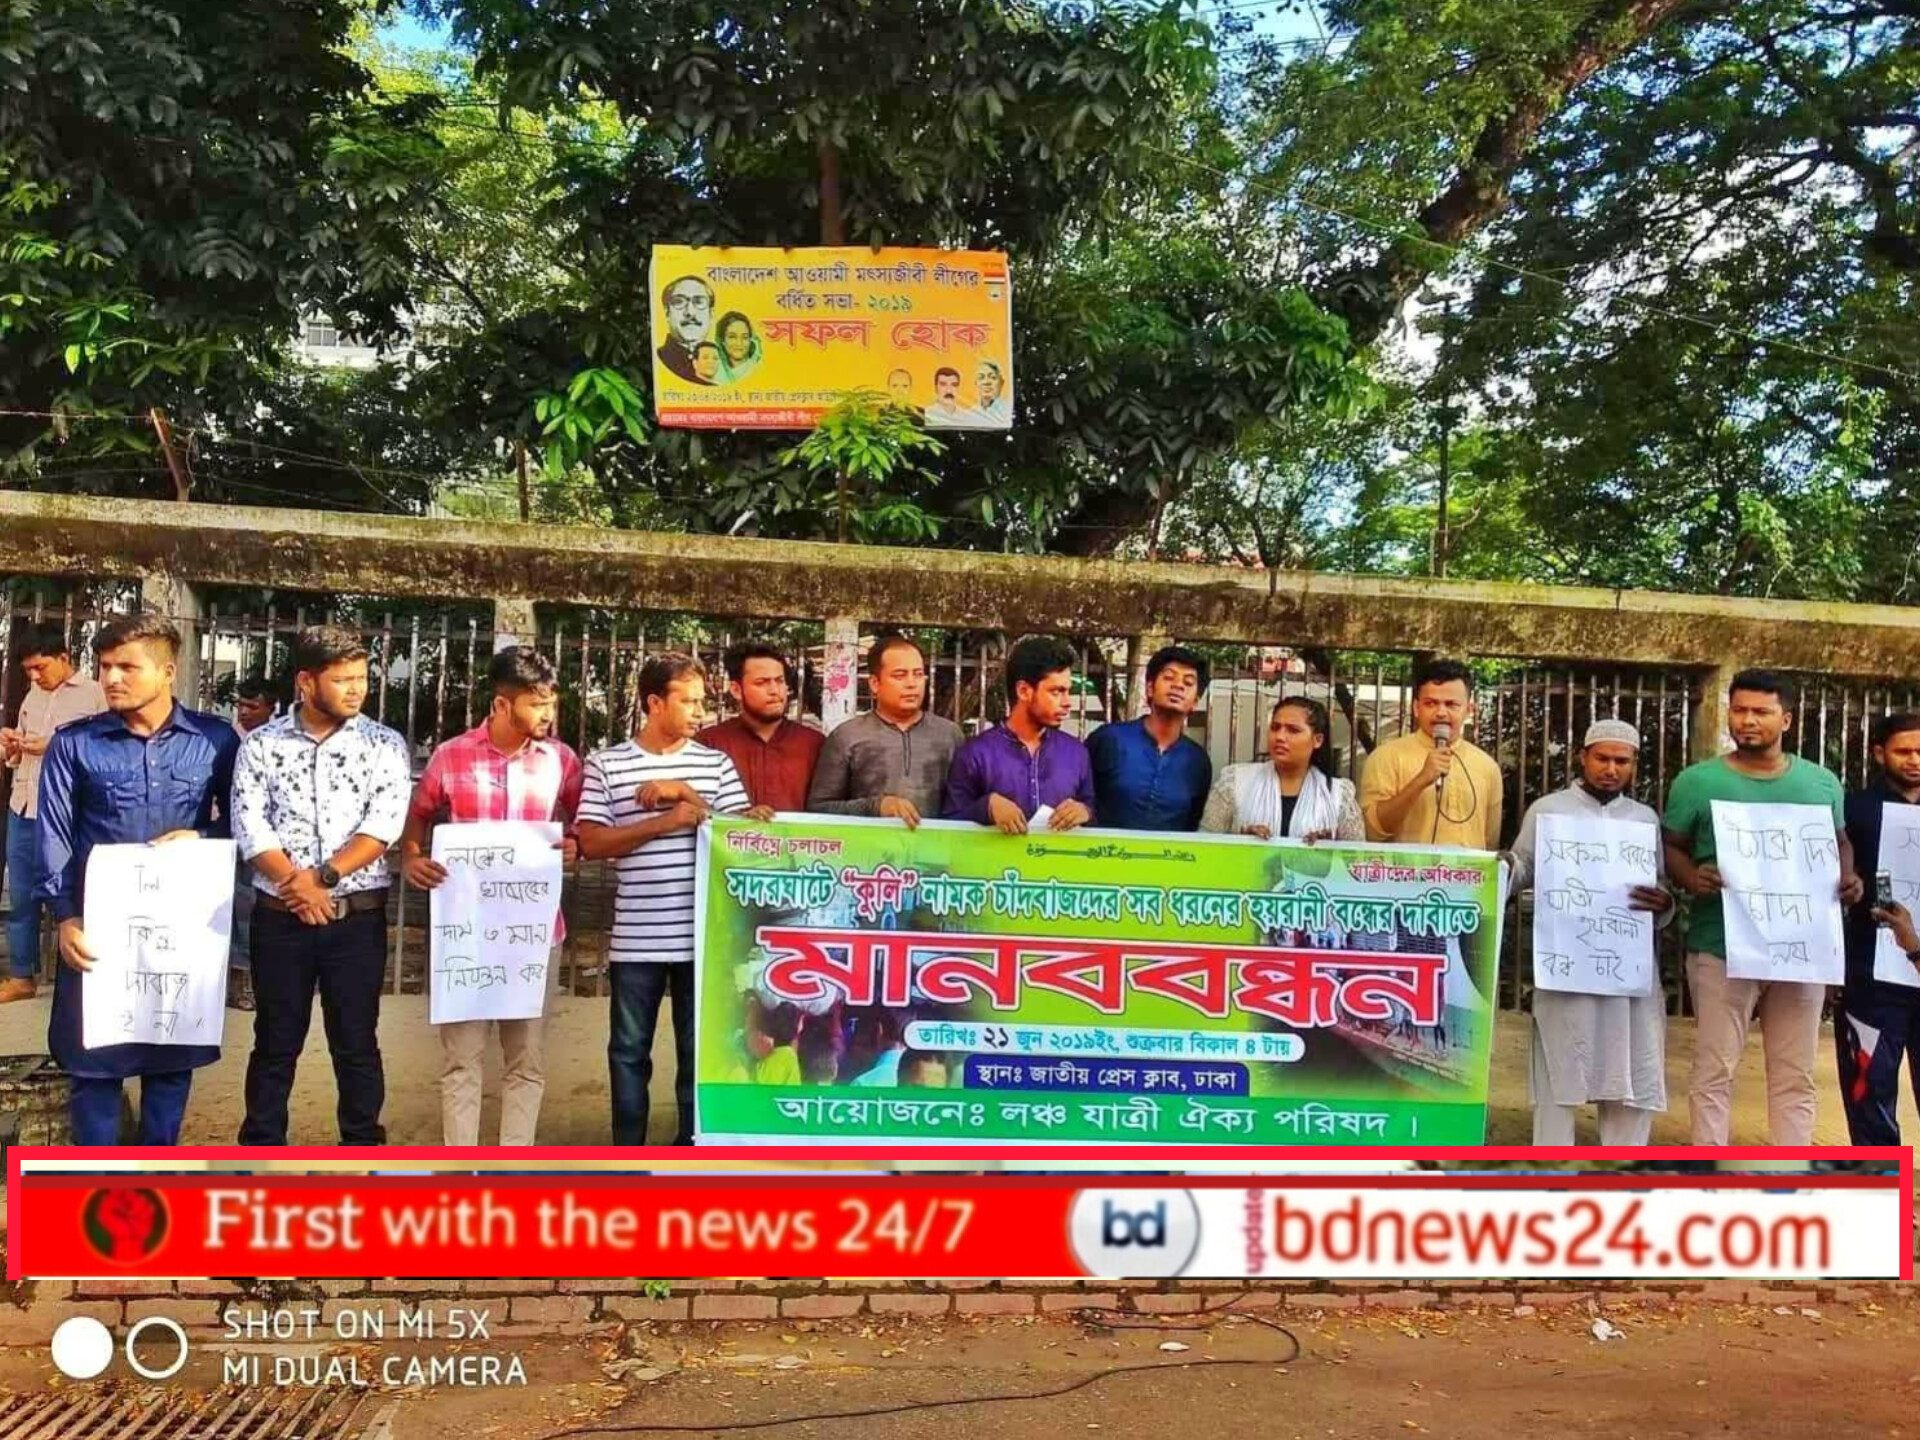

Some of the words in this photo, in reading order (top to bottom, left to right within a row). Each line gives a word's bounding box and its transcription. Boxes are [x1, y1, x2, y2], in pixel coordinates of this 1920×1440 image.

[706, 265, 778, 284] বাংলাদেশ
[787, 262, 849, 284] আওয়ামী
[867, 294, 913, 312] ২০১৯
[762, 319, 877, 350] সফল
[891, 318, 992, 352] হোক
[787, 837, 843, 855] চলাচল
[725, 861, 837, 908] সদরঘাটে
[920, 876, 989, 915] নামক
[1124, 886, 1165, 924] সব
[1169, 888, 1245, 928] ধরনের
[1247, 883, 1328, 933] হয়রানী
[1330, 895, 1397, 934] বন্ধের
[1398, 889, 1481, 937] দাবীতে
[756, 927, 1448, 1027] মানববন্ধন
[983, 1026, 1010, 1049] ২১
[1014, 1030, 1043, 1051] জুন
[1189, 1032, 1239, 1055] বিকাল
[1245, 1040, 1256, 1055] ৪
[1261, 1036, 1292, 1056] টায়
[1028, 1061, 1090, 1085] জাতীয়
[1097, 1067, 1136, 1088] প্রেস
[1192, 1070, 1237, 1090] ঢাকা
[998, 1102, 1067, 1128] লঞ্চ
[1080, 1096, 1162, 1132] যাত্রী
[1178, 1097, 1257, 1134] ঐক্য
[1273, 1102, 1390, 1137] পরিষদ
